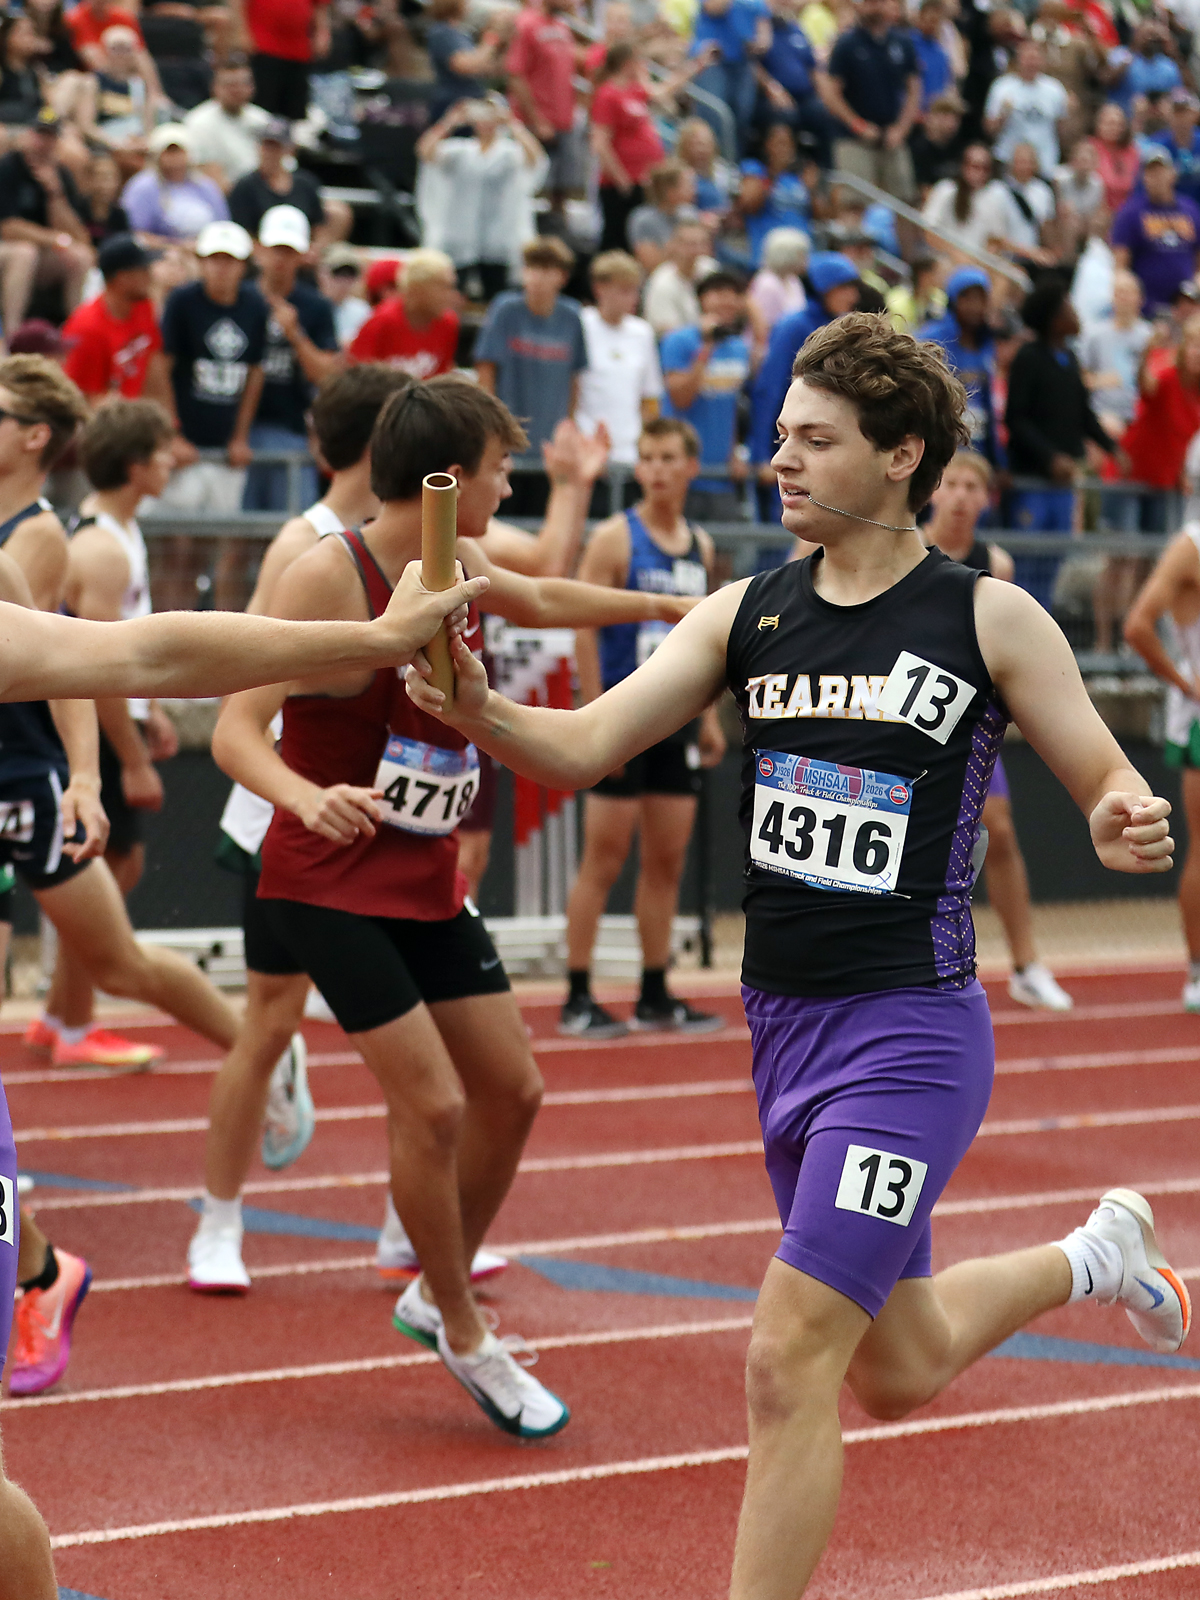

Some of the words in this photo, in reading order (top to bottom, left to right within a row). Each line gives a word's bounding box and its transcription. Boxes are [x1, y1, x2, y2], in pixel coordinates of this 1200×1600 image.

[745, 673, 909, 724] KEARN
[899, 664, 959, 731] 13
[777, 765, 791, 777] 1926
[802, 768, 849, 792] MSHSAA
[383, 775, 474, 821] 4718
[800, 785, 815, 796] Track
[815, 789, 821, 797] &
[821, 791, 835, 800] Field
[835, 794, 879, 811] Championships
[865, 784, 884, 796] 2026
[758, 800, 893, 876] 4316
[789, 871, 805, 880] Track
[805, 874, 818, 883] and
[818, 877, 833, 886] Field
[832, 880, 883, 895] Championships
[858, 1153, 913, 1218] 13
